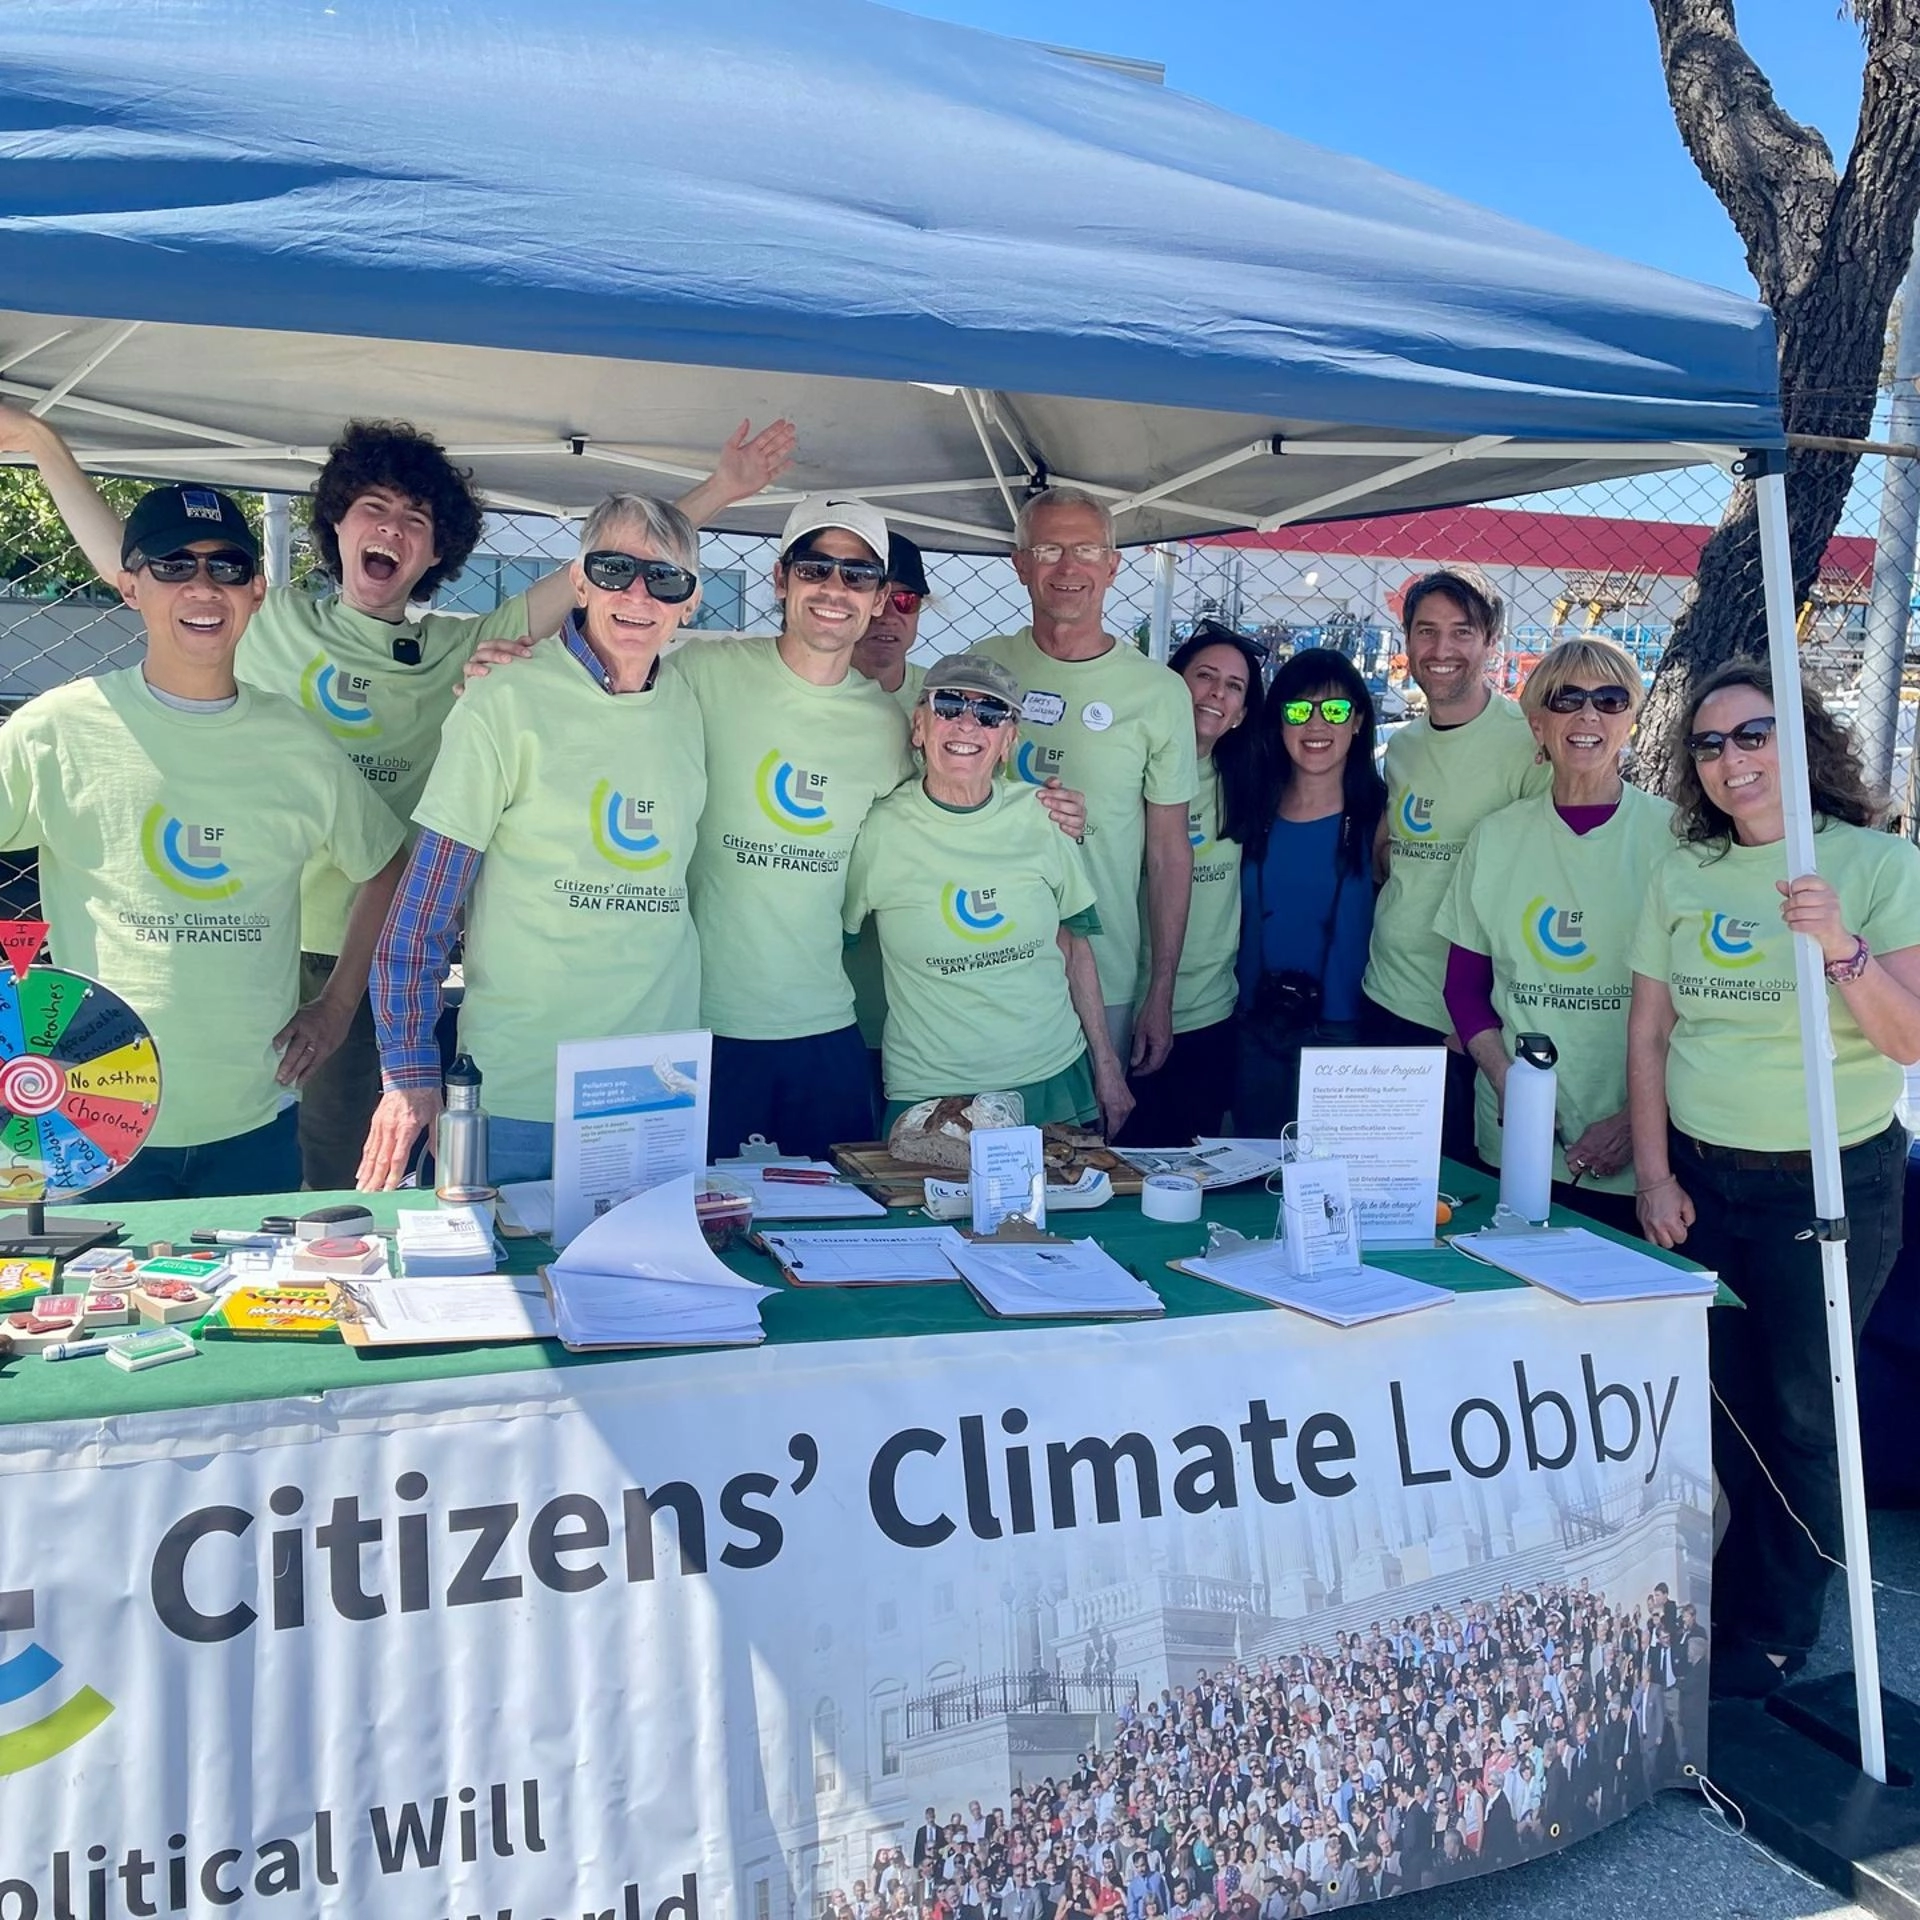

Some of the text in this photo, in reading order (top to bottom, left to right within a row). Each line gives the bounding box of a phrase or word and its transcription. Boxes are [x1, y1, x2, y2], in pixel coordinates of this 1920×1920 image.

[352, 678, 372, 690] SF
[377, 755, 413, 769] Lobby
[1048, 750, 1065, 761] SF
[810, 774, 828, 787] SF
[637, 800, 655, 813] SF
[204, 828, 225, 841] SF
[723, 834, 778, 853] Citizens'
[781, 844, 826, 859] Climate
[736, 851, 839, 873] SAN FRANCISCO
[554, 879, 614, 895] Citizens'
[616, 883, 667, 897] Climate
[982, 889, 997, 900] SF
[569, 895, 601, 910] SAN
[118, 912, 179, 925] Citizens'
[184, 913, 241, 925] Climate
[4, 938, 35, 948] LOVE
[136, 929, 262, 943] SAN FRANCISCO
[975, 946, 1016, 961] Climate
[940, 949, 1035, 976] SAN FRANCISCO
[1549, 984, 1594, 996] Climate
[1709, 976, 1756, 988] Climate
[1760, 979, 1798, 992] Lobby
[1678, 985, 1781, 1002] SAN FRANCISCO
[1513, 993, 1621, 1010] SAN FRANCISCO
[31, 983, 65, 1049] Beaches
[1352, 1064, 1368, 1075] has
[1370, 1064, 1390, 1075] New
[71, 1070, 158, 1089] No asthma
[67, 1096, 145, 1138] Chocolate
[257, 1289, 328, 1298] Crayo
[151, 1353, 1680, 1645] Citizens' Climate Lobby
[0, 1809, 339, 1920] olitical
[369, 1778, 547, 1875] Will
